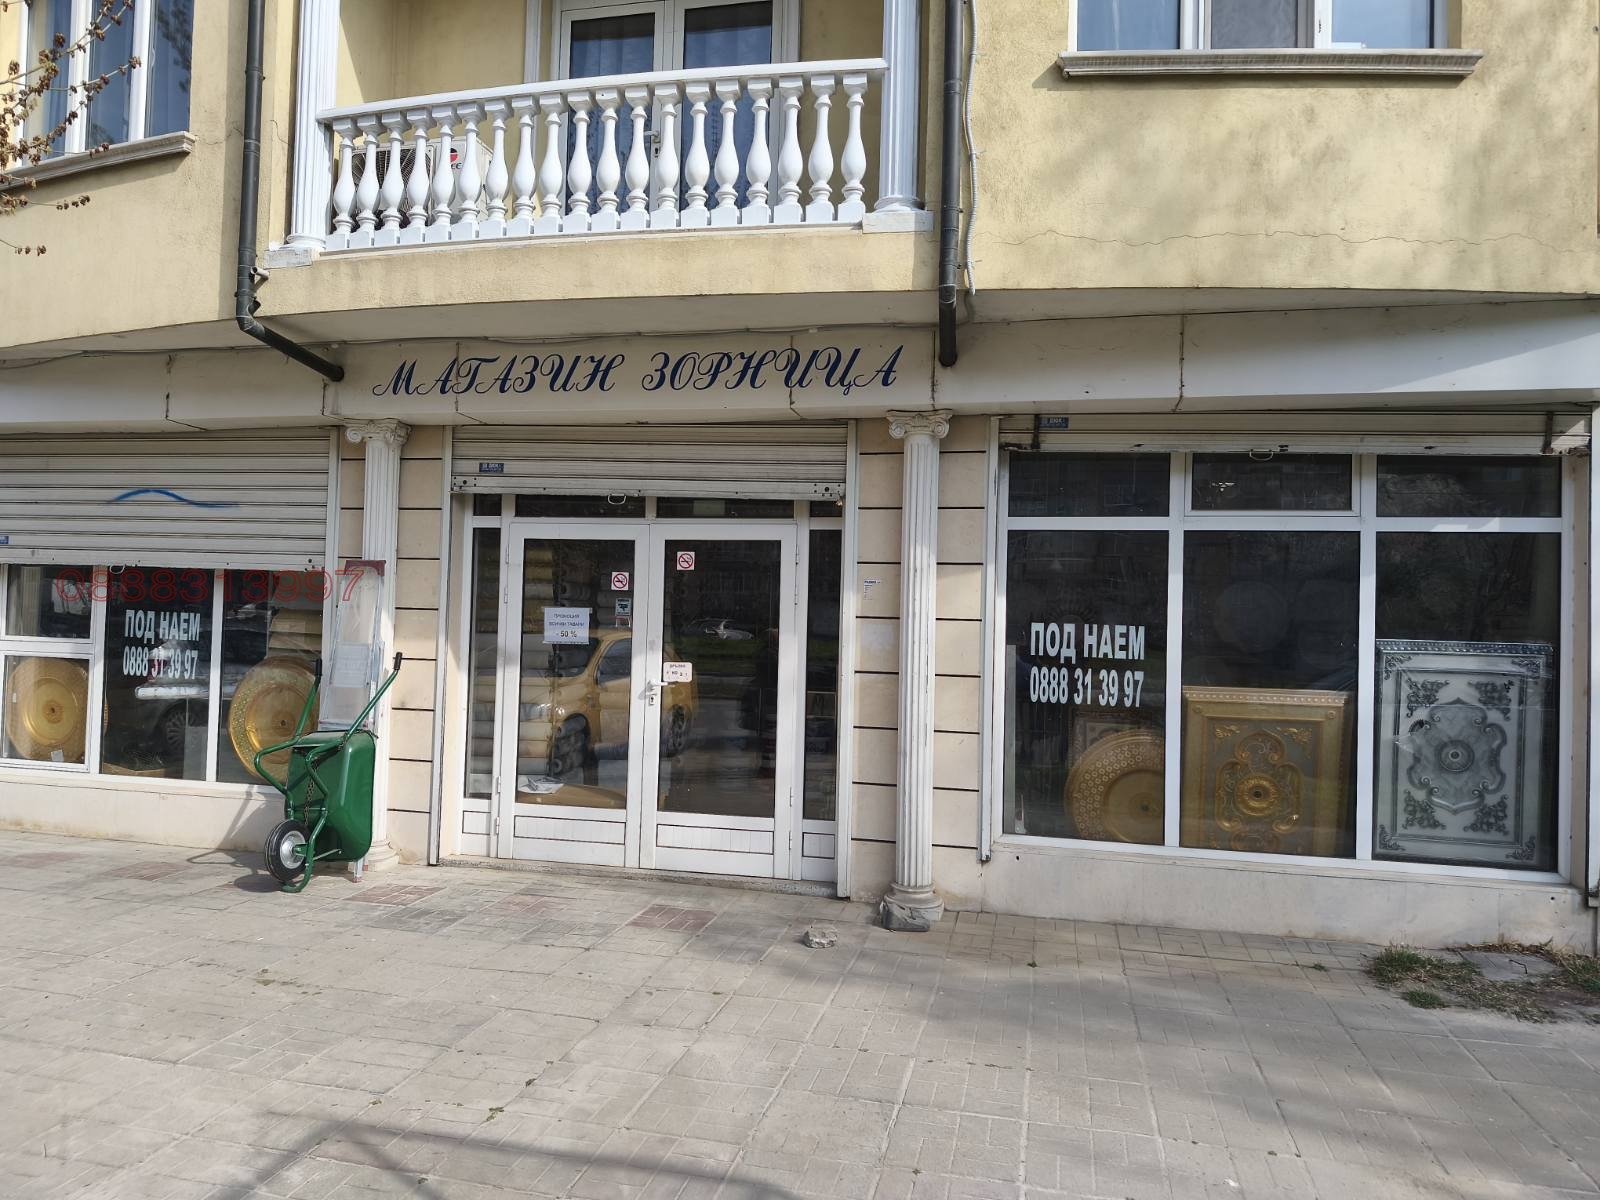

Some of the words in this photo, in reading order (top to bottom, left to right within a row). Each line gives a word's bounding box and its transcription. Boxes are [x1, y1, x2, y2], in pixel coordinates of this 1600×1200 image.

[372, 353, 625, 396] МАГАЗИН
[641, 345, 904, 396] ЗОРНИЦА
[124, 609, 156, 645] ПОД
[159, 611, 201, 642] НАЕМ
[560, 630, 569, 638] 50
[1030, 622, 1077, 665] ПОД
[1083, 623, 1146, 661] НАЕМ
[123, 646, 149, 677] 0888
[151, 647, 164, 678] 31
[168, 648, 181, 679] 39
[184, 649, 199, 680] 97
[1029, 666, 1069, 704] 0888
[1073, 668, 1092, 705] 31
[1098, 669, 1119, 707] 39
[1123, 670, 1145, 708] 97
